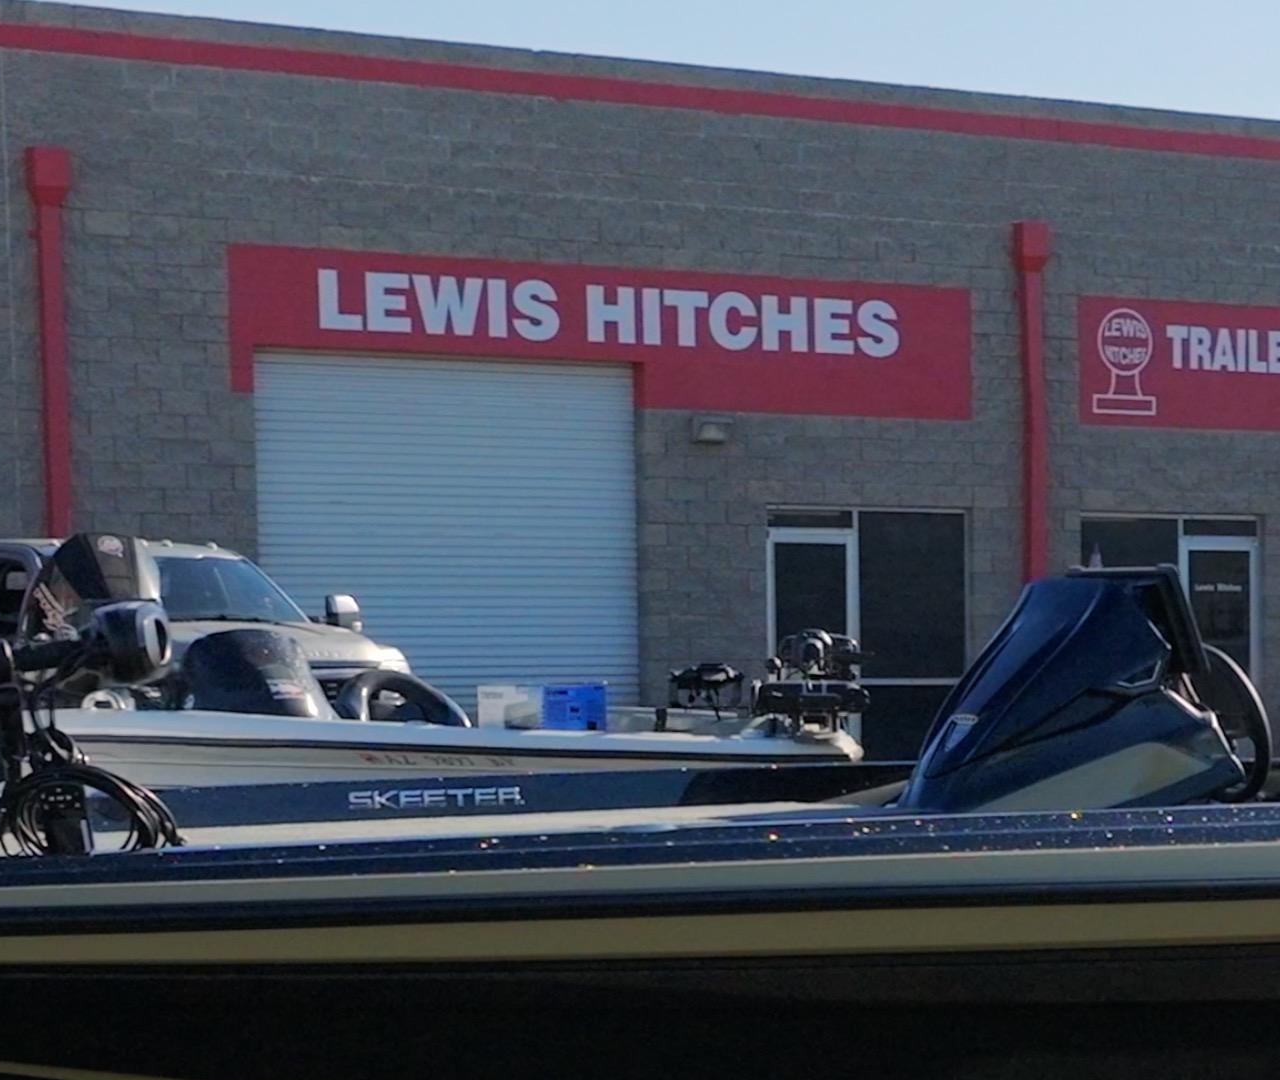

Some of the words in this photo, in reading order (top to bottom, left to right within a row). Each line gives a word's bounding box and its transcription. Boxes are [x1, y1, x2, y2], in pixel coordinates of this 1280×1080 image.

[318, 268, 560, 342] LEWIS
[585, 284, 900, 359] HITCHES
[1103, 318, 1148, 339] LEWIS
[347, 786, 522, 810] SKEETER
